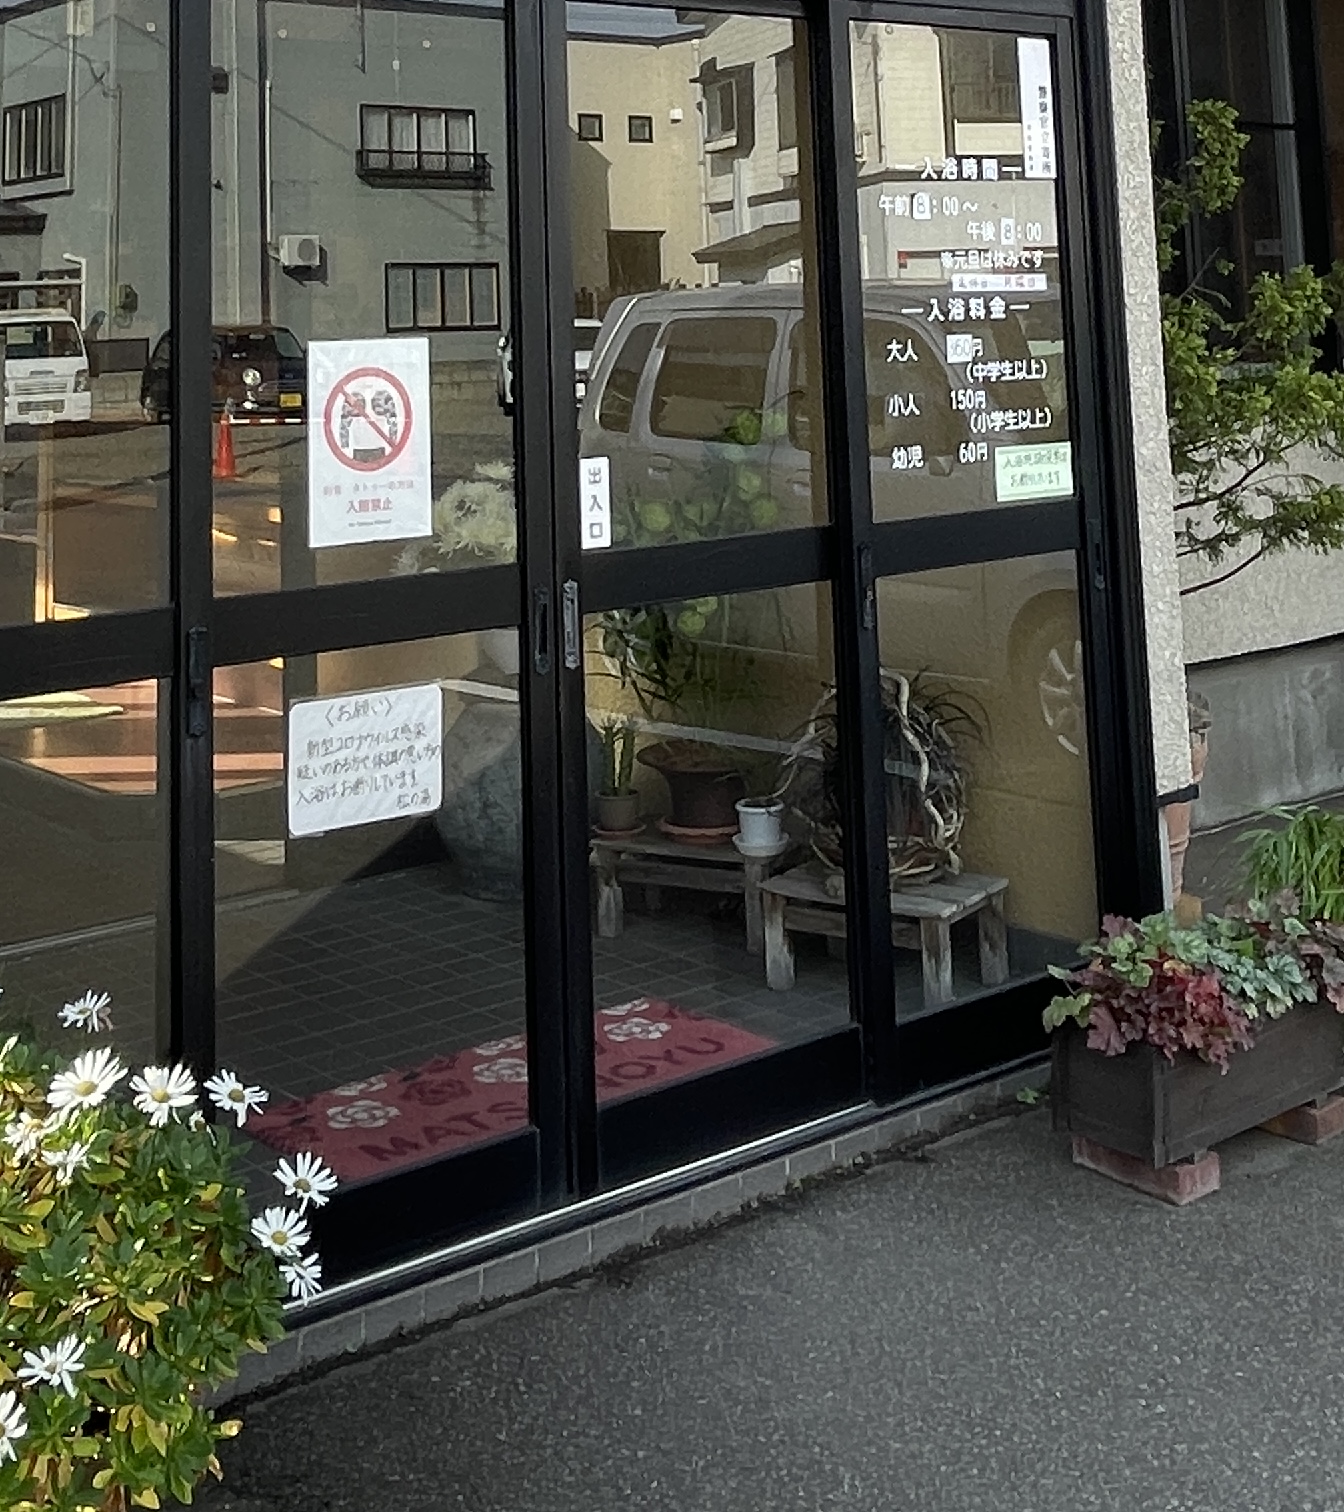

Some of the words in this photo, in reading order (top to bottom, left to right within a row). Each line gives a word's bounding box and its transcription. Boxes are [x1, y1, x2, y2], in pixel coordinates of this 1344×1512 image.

[886, 338, 919, 363] 大人
[888, 392, 920, 418] 小人
[950, 389, 987, 410] 150円
[970, 407, 1052, 433] (小学生以上)
[891, 444, 924, 471] 幼児
[959, 441, 988, 464] 60円
[588, 467, 604, 539] 出入口
